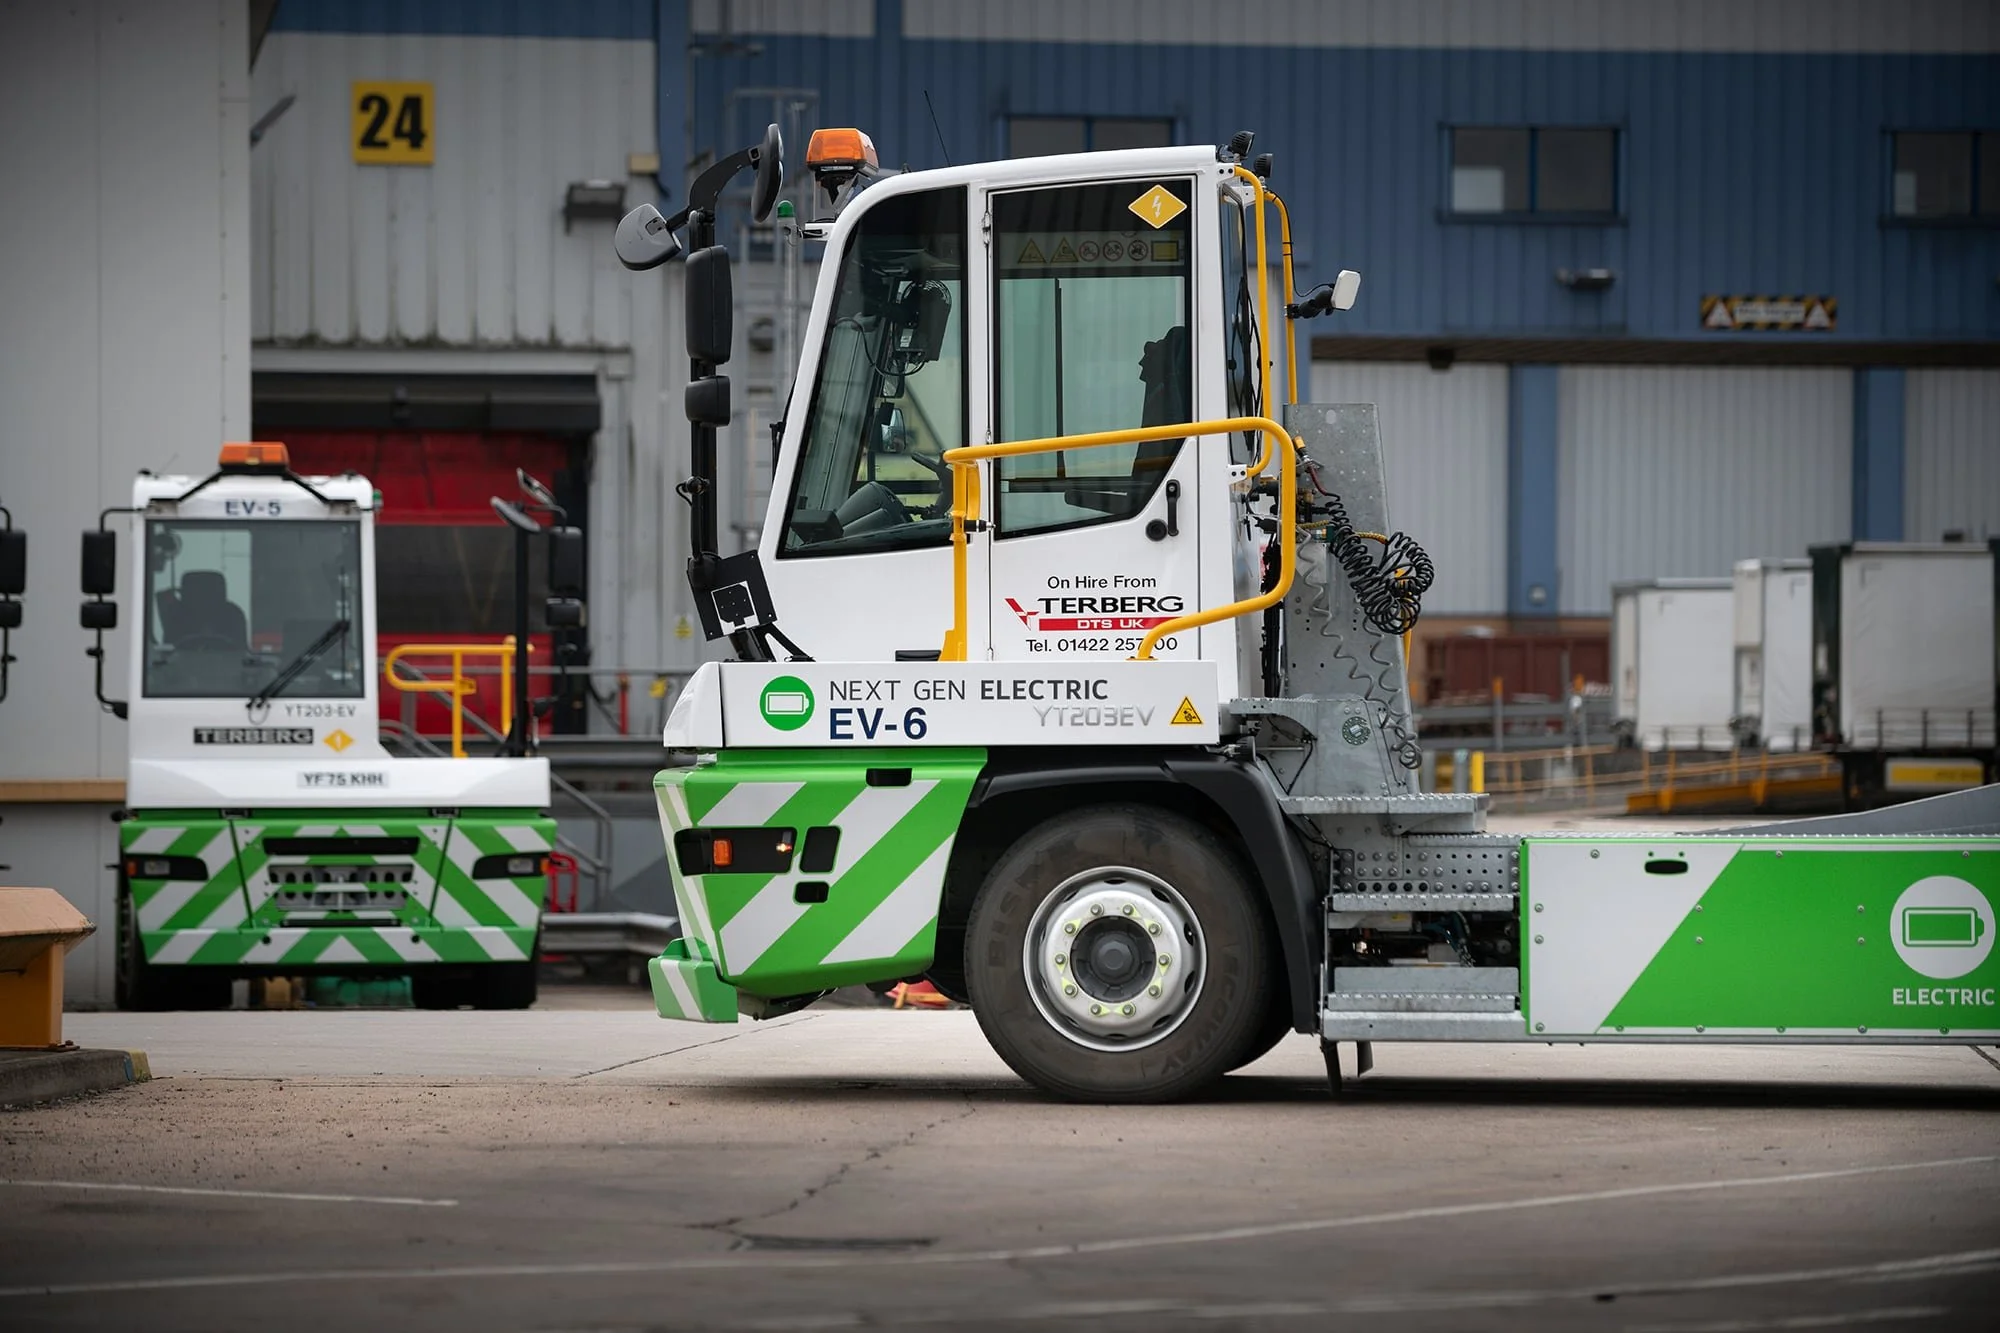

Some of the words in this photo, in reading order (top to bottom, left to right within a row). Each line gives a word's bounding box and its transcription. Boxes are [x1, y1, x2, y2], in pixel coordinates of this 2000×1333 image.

[359, 93, 426, 149] 24
[225, 501, 281, 516] EV-5
[1047, 575, 1070, 589] On
[1075, 575, 1108, 589] Hire
[1113, 575, 1157, 588] From
[1037, 596, 1184, 614] TERBERG
[1077, 618, 1112, 629] DTS
[1119, 618, 1144, 629] UK
[1025, 639, 1052, 652] Tel.
[1057, 638, 1109, 652] 01422
[1115, 637, 1178, 651] 25700
[830, 680, 901, 701] NEXT
[913, 680, 966, 701] GEN
[980, 679, 1109, 701] ELECTRIC
[829, 706, 928, 740] EV-6
[1032, 705, 1156, 728] YT203EV
[196, 729, 312, 744] TERBERG
[1892, 987, 1995, 1006] ELECTRIC
